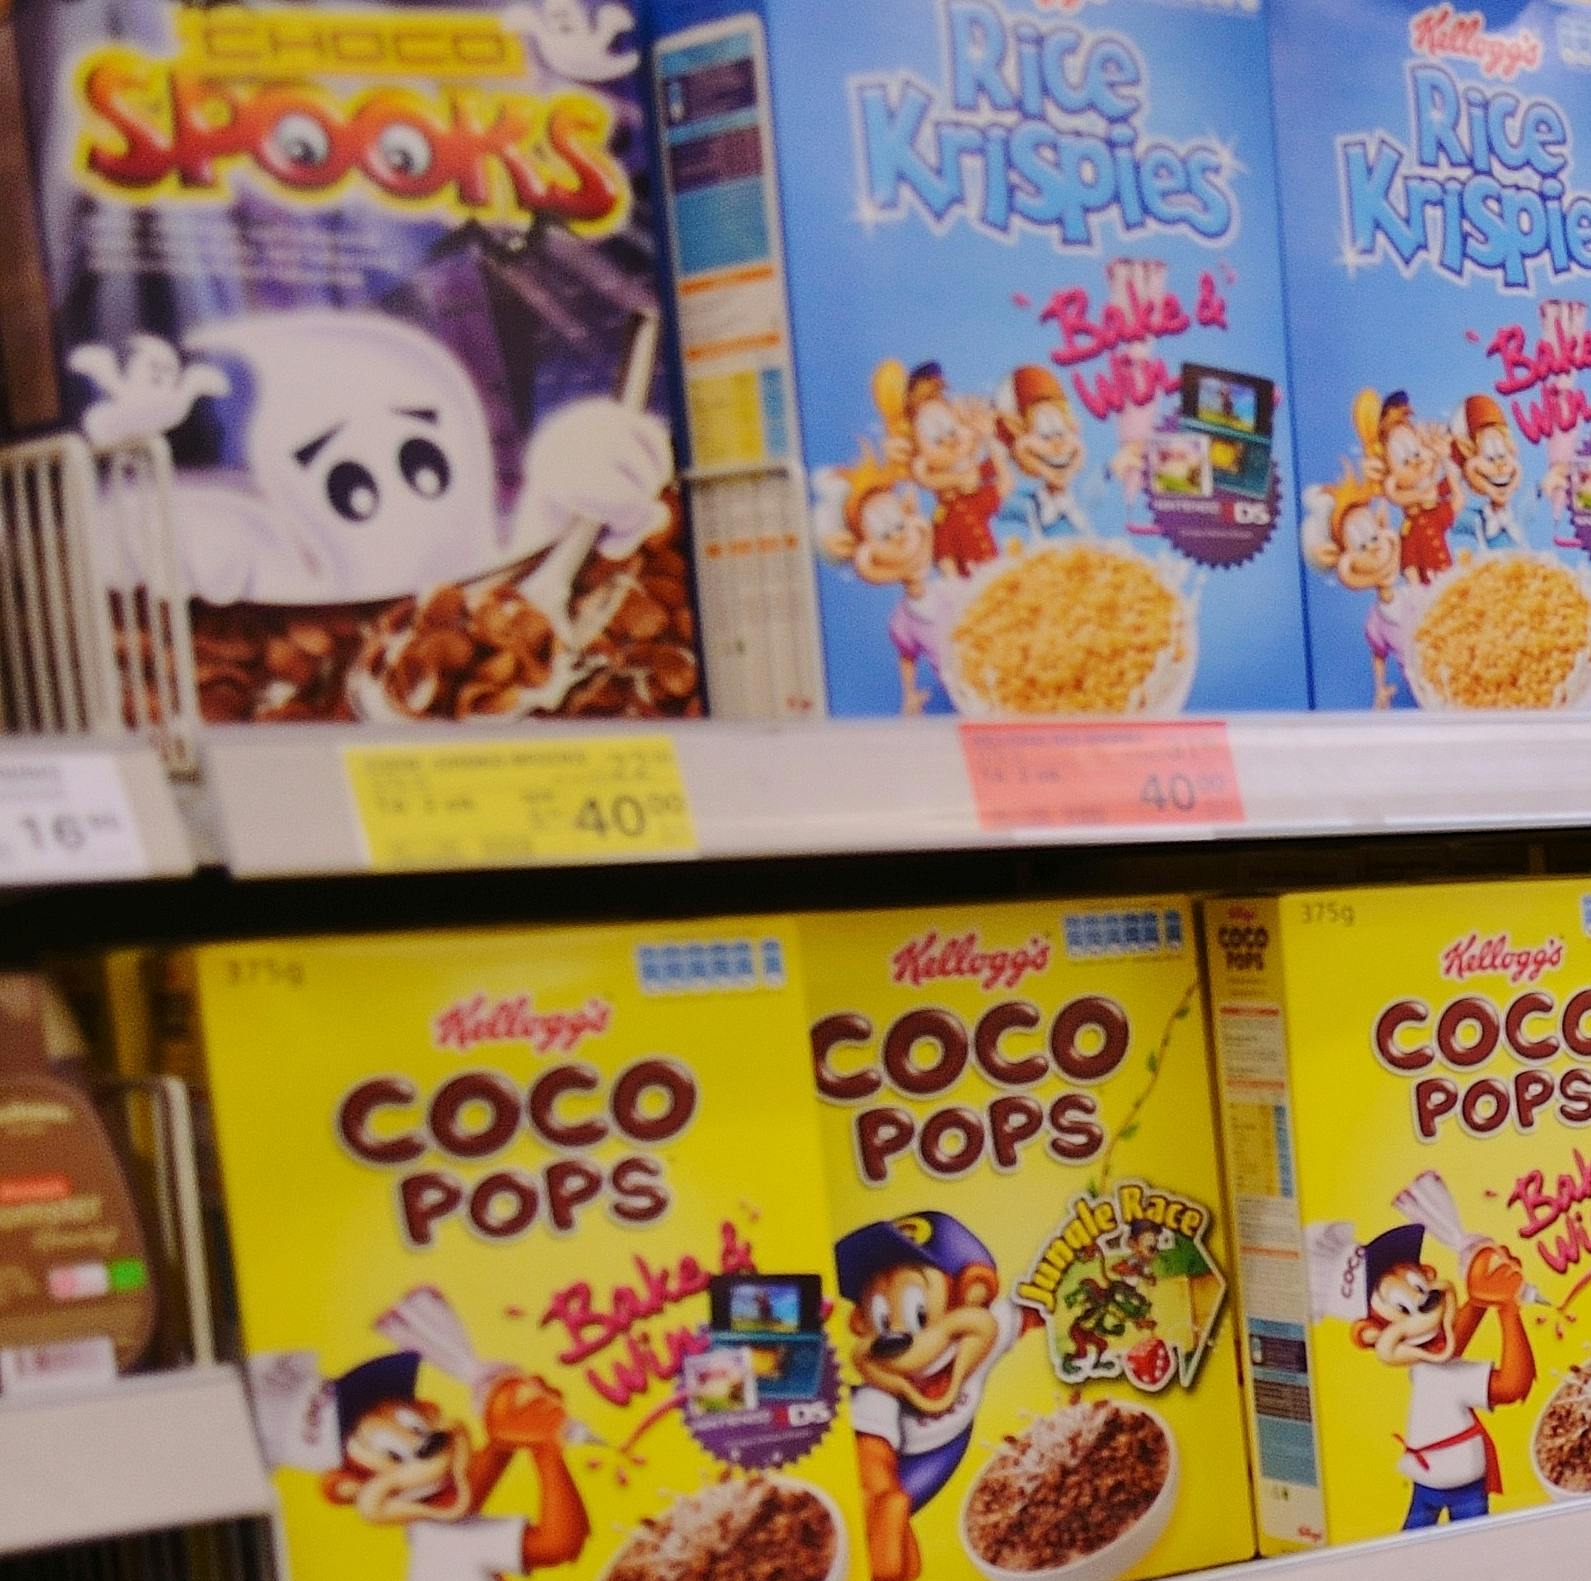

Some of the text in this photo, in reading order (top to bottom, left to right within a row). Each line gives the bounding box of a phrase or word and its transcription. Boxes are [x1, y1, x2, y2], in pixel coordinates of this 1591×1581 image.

[203, 14, 507, 66] CHOCO
[84, 52, 622, 222] SPOOKS
[857, 80, 1234, 246] Krispies
[1412, 66, 1571, 178] Rice
[892, 933, 1052, 990] Kellogg's
[435, 997, 614, 1052] Kellogg's
[810, 995, 1132, 1102] COCO
[337, 1058, 698, 1166] COCO
[854, 1093, 1105, 1183] POPS
[400, 1155, 670, 1247] POPS
[1119, 1180, 1203, 1236] Race
[1018, 1195, 1117, 1310] Jungle
